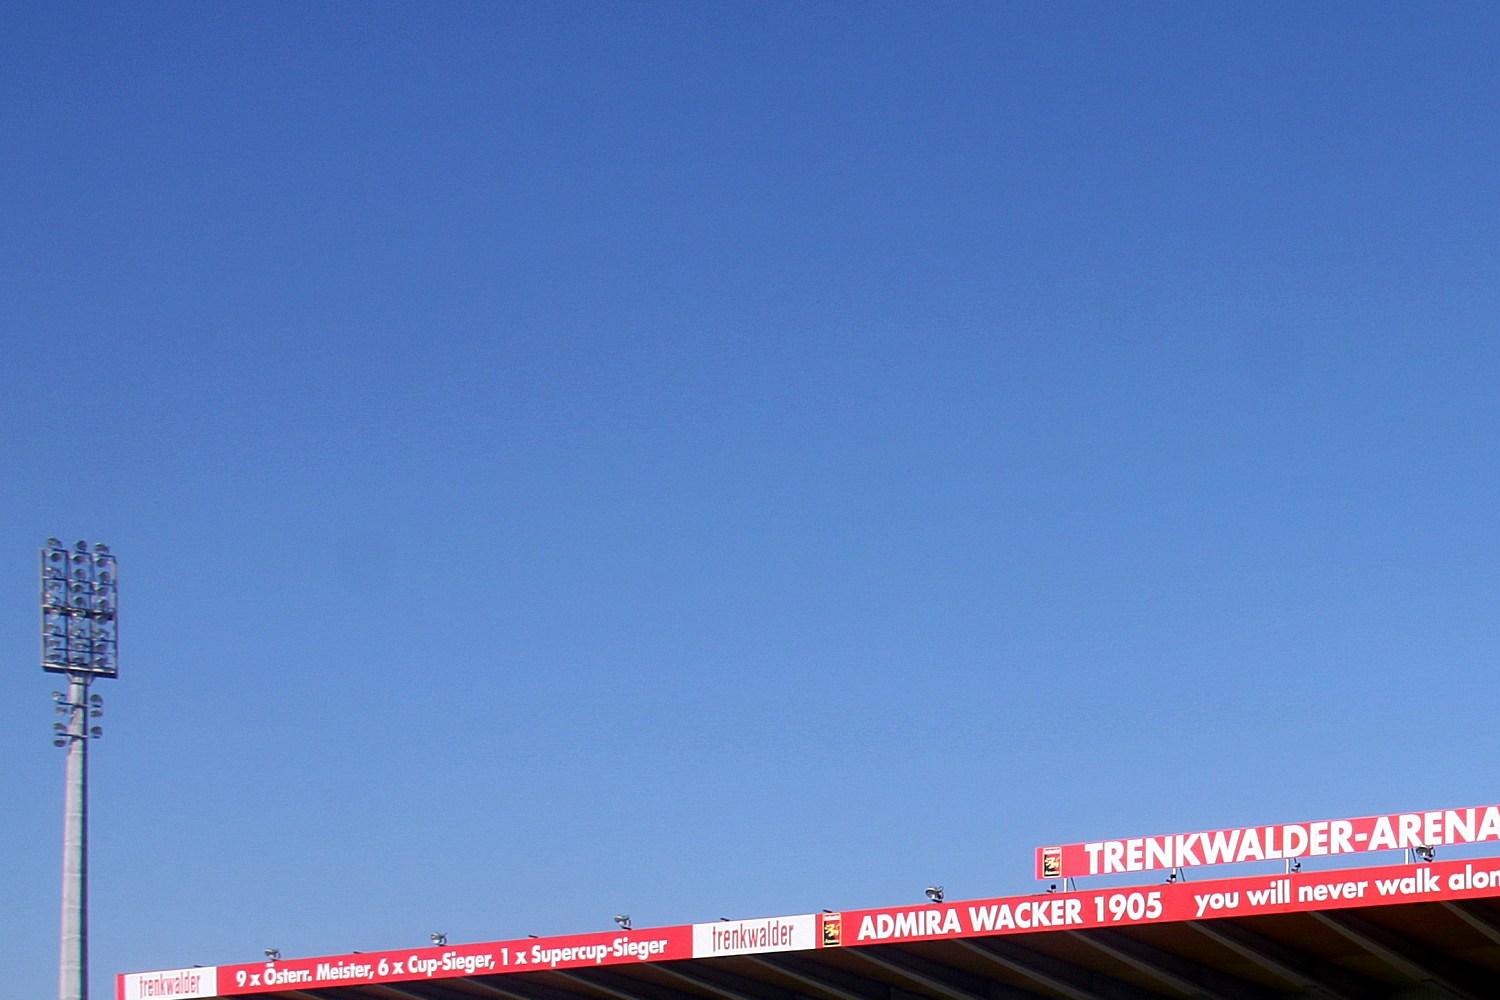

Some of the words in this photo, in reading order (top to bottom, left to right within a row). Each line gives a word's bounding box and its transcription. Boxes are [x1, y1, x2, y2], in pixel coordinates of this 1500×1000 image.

[857, 905, 967, 941] ADMIRA
[969, 898, 1083, 932] WACKER
[1094, 892, 1164, 921] 1905
[1194, 891, 1239, 917] you
[1247, 880, 1291, 905] will
[1299, 880, 1366, 903] never
[1374, 868, 1441, 896] walk
[712, 920, 794, 952] trenkwalder
[139, 971, 201, 998] trenkwalder
[236, 970, 247, 988] 9
[249, 974, 261, 986] x
[265, 963, 312, 985] Österr.
[316, 959, 375, 981] Meister,
[377, 958, 389, 976] 6
[392, 962, 403, 974] x
[408, 951, 496, 976] Cup-Sieger,
[500, 947, 509, 966] 1
[514, 950, 527, 964] x
[531, 937, 668, 965] Supercup-Sieger
